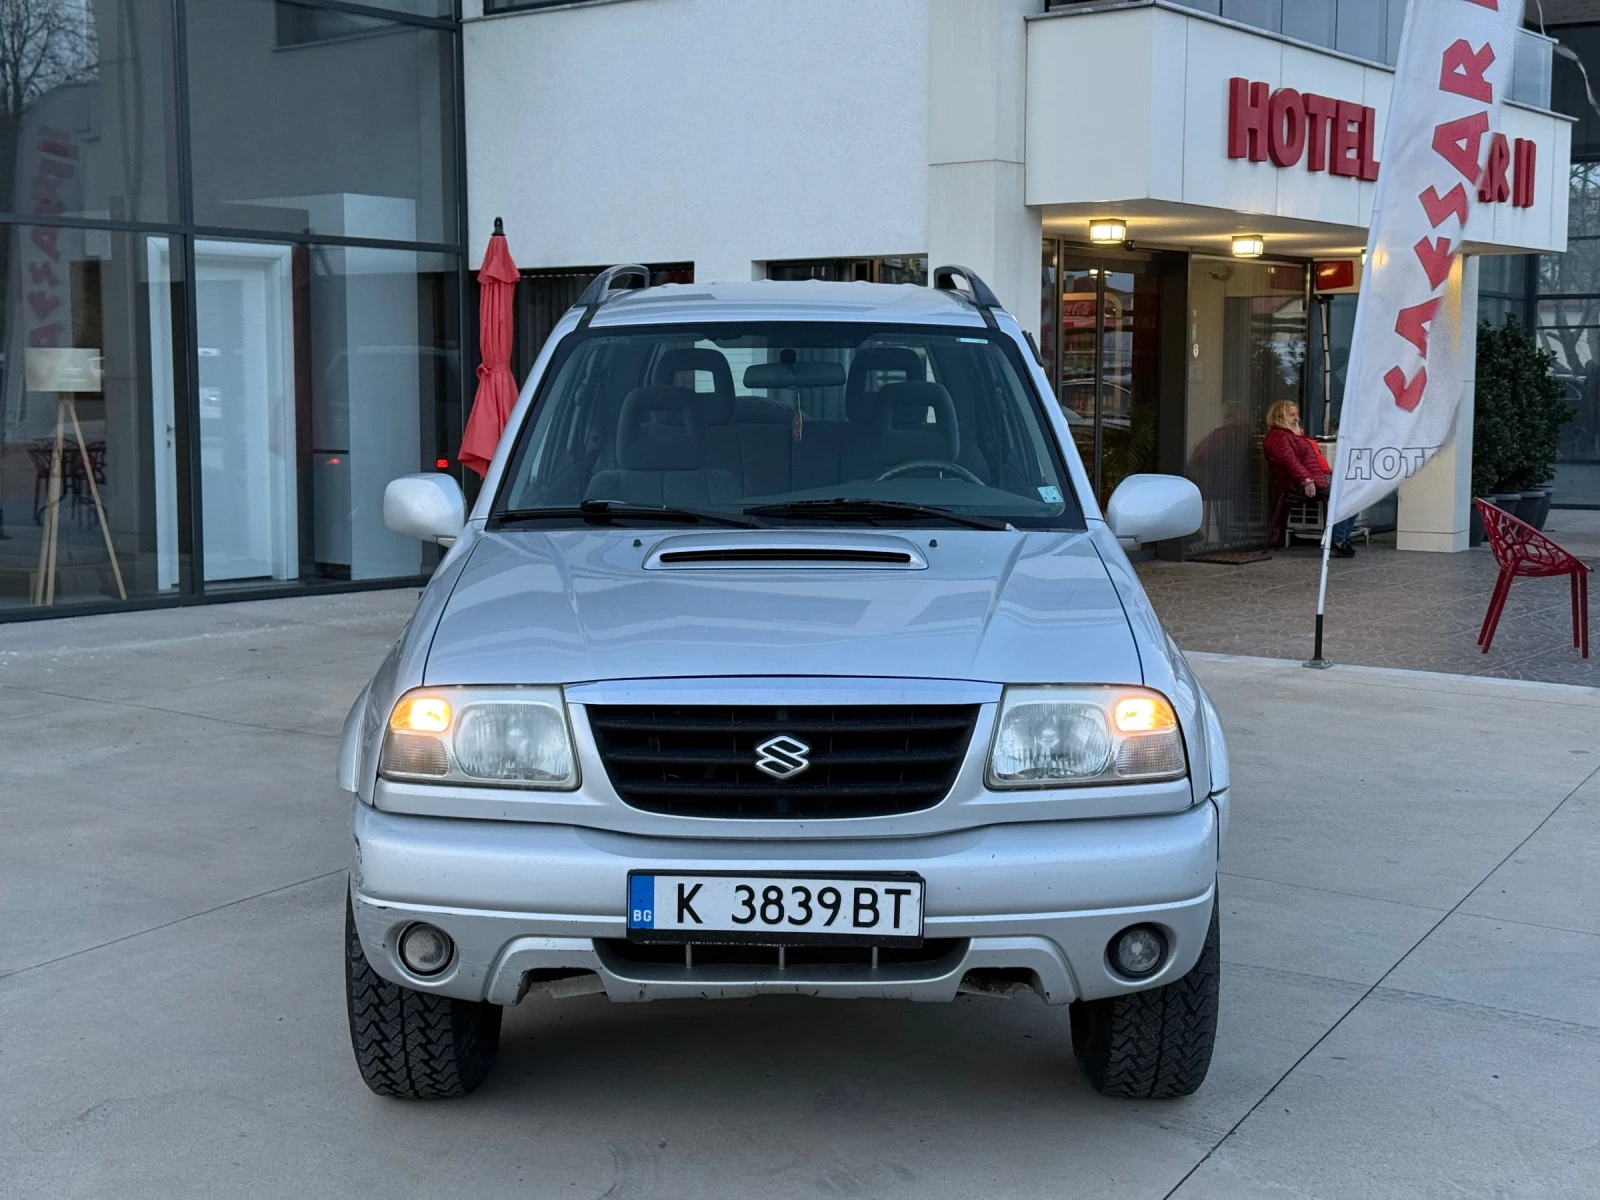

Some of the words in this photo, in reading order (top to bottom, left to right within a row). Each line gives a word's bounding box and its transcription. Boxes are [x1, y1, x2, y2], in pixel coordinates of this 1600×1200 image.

[1228, 77, 1380, 182] HOTEL
[1345, 445, 1443, 480] HOT
[633, 909, 652, 922] BG
[677, 882, 703, 924] K
